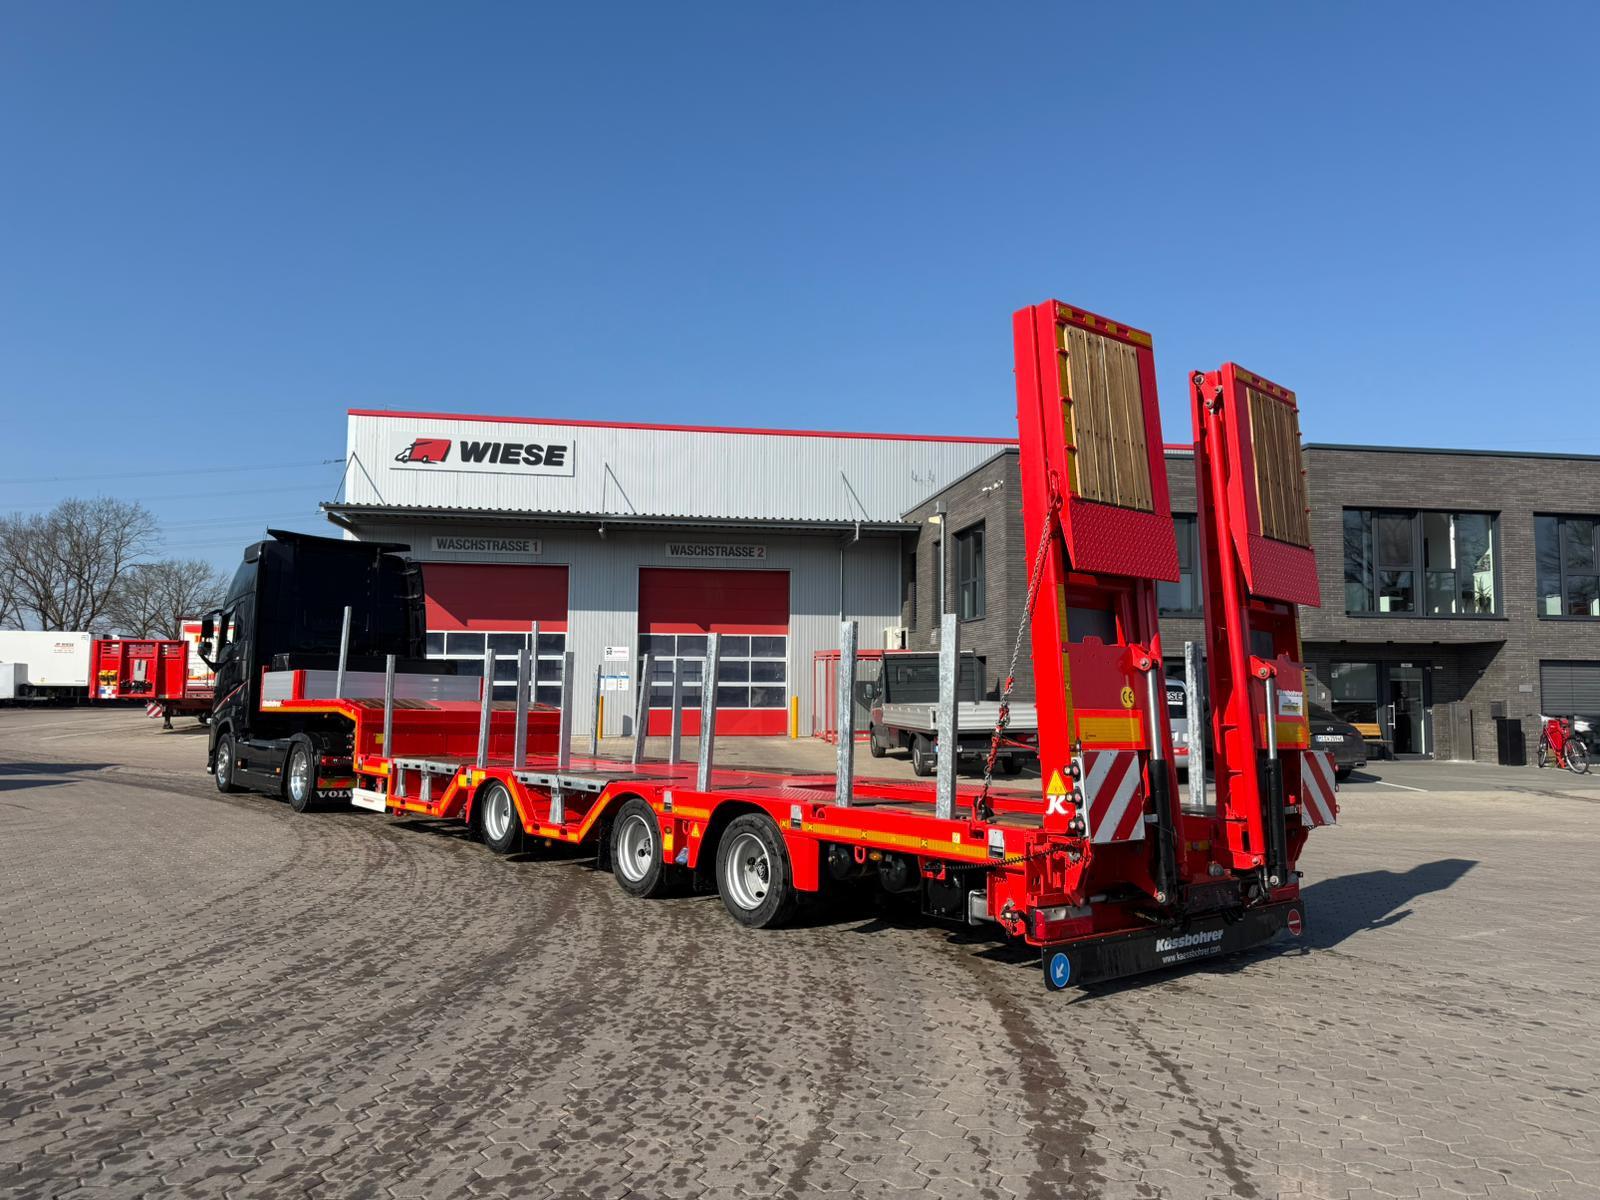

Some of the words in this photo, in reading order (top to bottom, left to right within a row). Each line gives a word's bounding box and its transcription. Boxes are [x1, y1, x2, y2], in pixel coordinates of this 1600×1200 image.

[460, 440, 567, 467] WIESE
[436, 538, 530, 552] WASCHSTRASSE
[533, 541, 538, 552] 1
[670, 544, 755, 557] WASCHSTRASSE
[757, 547, 764, 558] 2
[316, 790, 353, 798] VOLV
[1045, 794, 1069, 815] K
